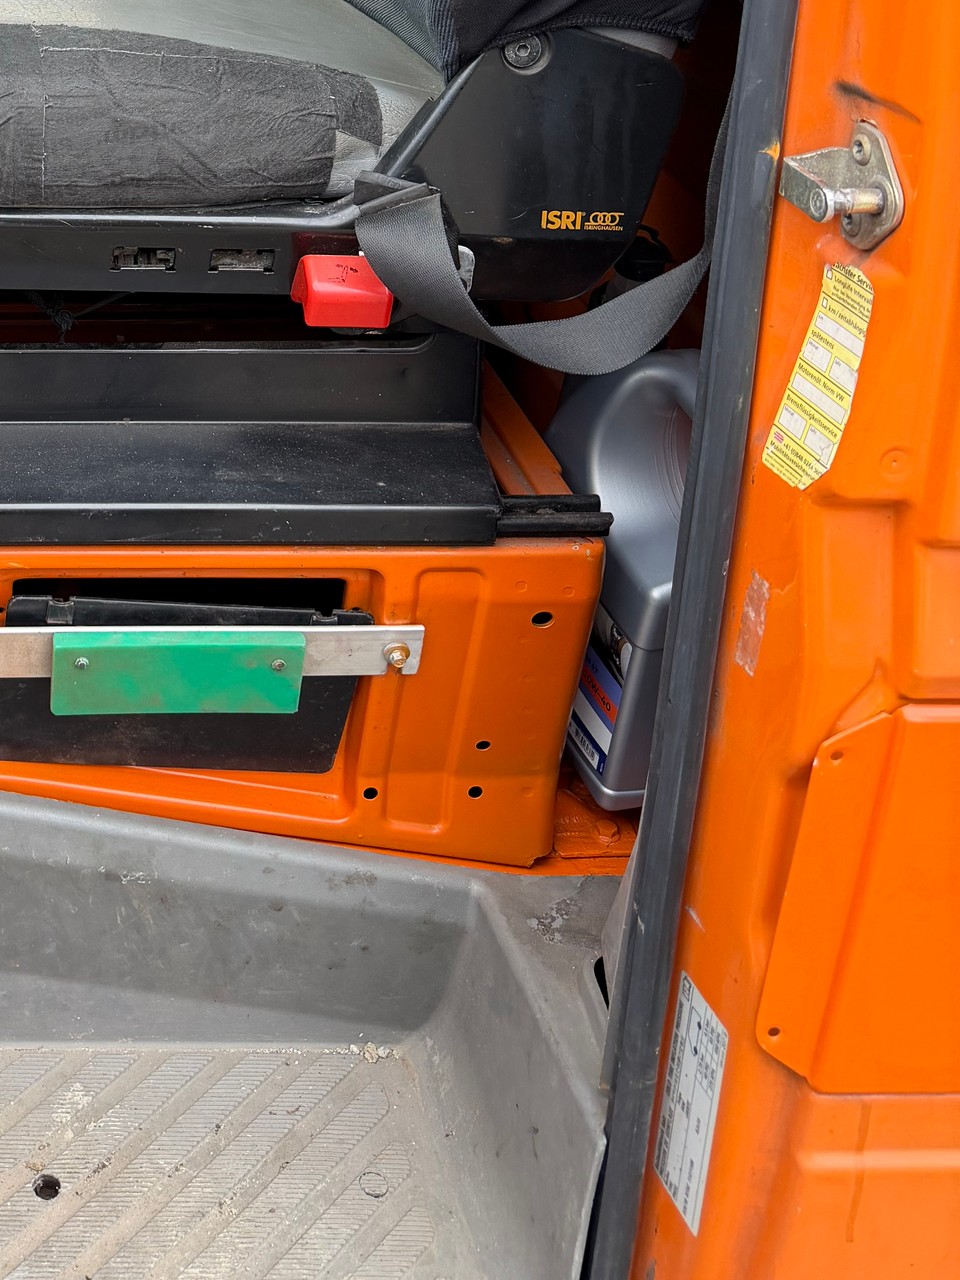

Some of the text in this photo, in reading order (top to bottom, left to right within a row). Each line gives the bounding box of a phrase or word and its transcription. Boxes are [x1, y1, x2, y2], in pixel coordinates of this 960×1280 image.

[811, 330, 835, 349] spätestens
[822, 381, 836, 395] Norm
[836, 390, 845, 402] VW
[786, 393, 838, 438] Bremsflüssigkeitsservice
